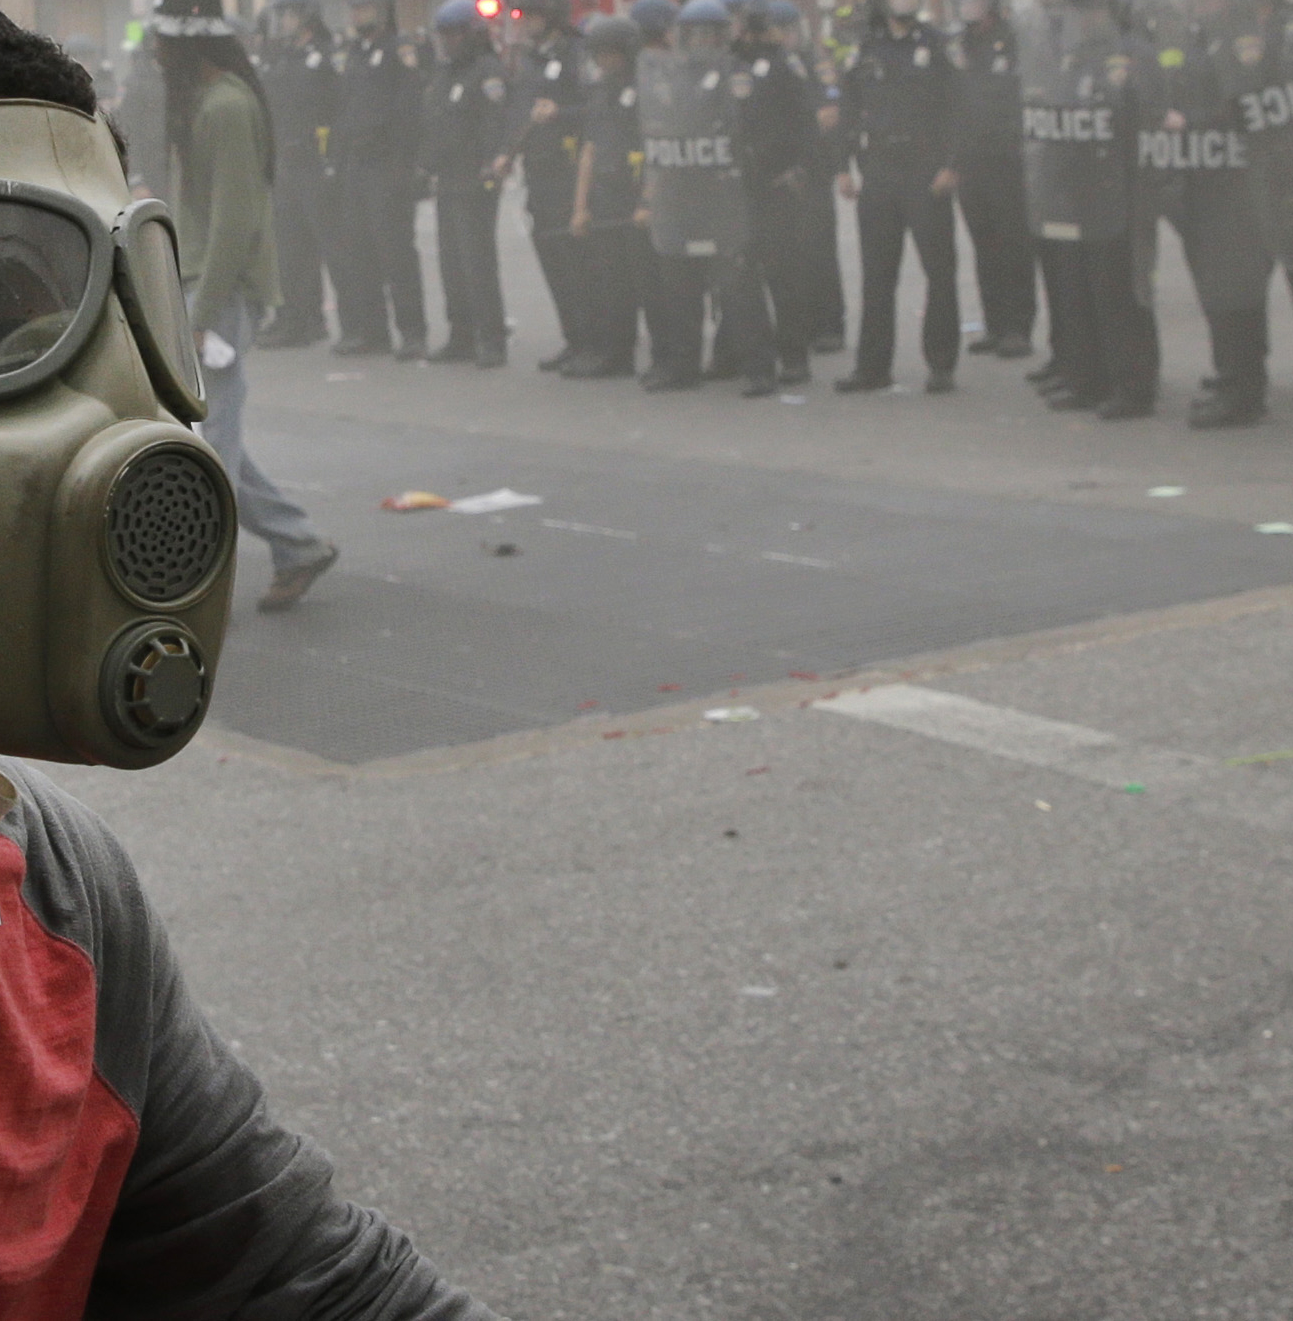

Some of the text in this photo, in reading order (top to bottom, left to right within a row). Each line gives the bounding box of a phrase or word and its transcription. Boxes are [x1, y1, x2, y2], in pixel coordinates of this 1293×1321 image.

[1022, 106, 1114, 141] POLICE
[646, 135, 733, 167] POLICE
[1137, 129, 1249, 169] POLICE
